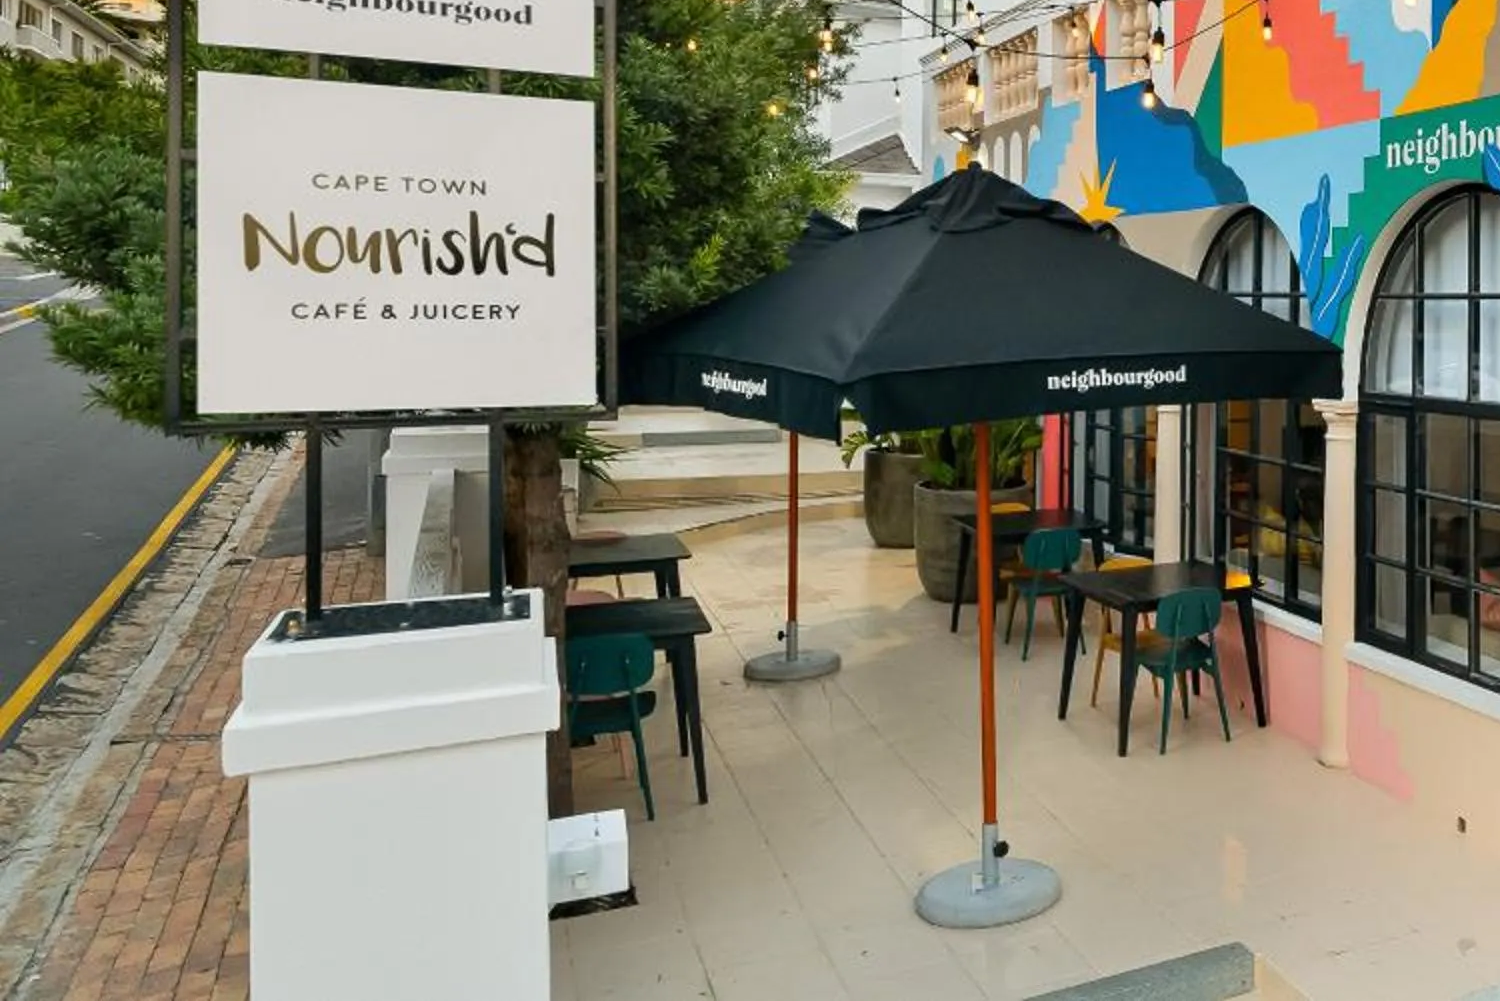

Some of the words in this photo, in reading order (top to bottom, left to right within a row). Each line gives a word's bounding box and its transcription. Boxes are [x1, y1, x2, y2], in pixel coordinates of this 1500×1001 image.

[312, 173, 389, 192] CAPE
[401, 176, 487, 196] TOWN
[291, 297, 368, 320] CAFÉ
[381, 303, 397, 320] &
[409, 303, 521, 321] JUICERY
[1047, 364, 1187, 393] neighbourgood
